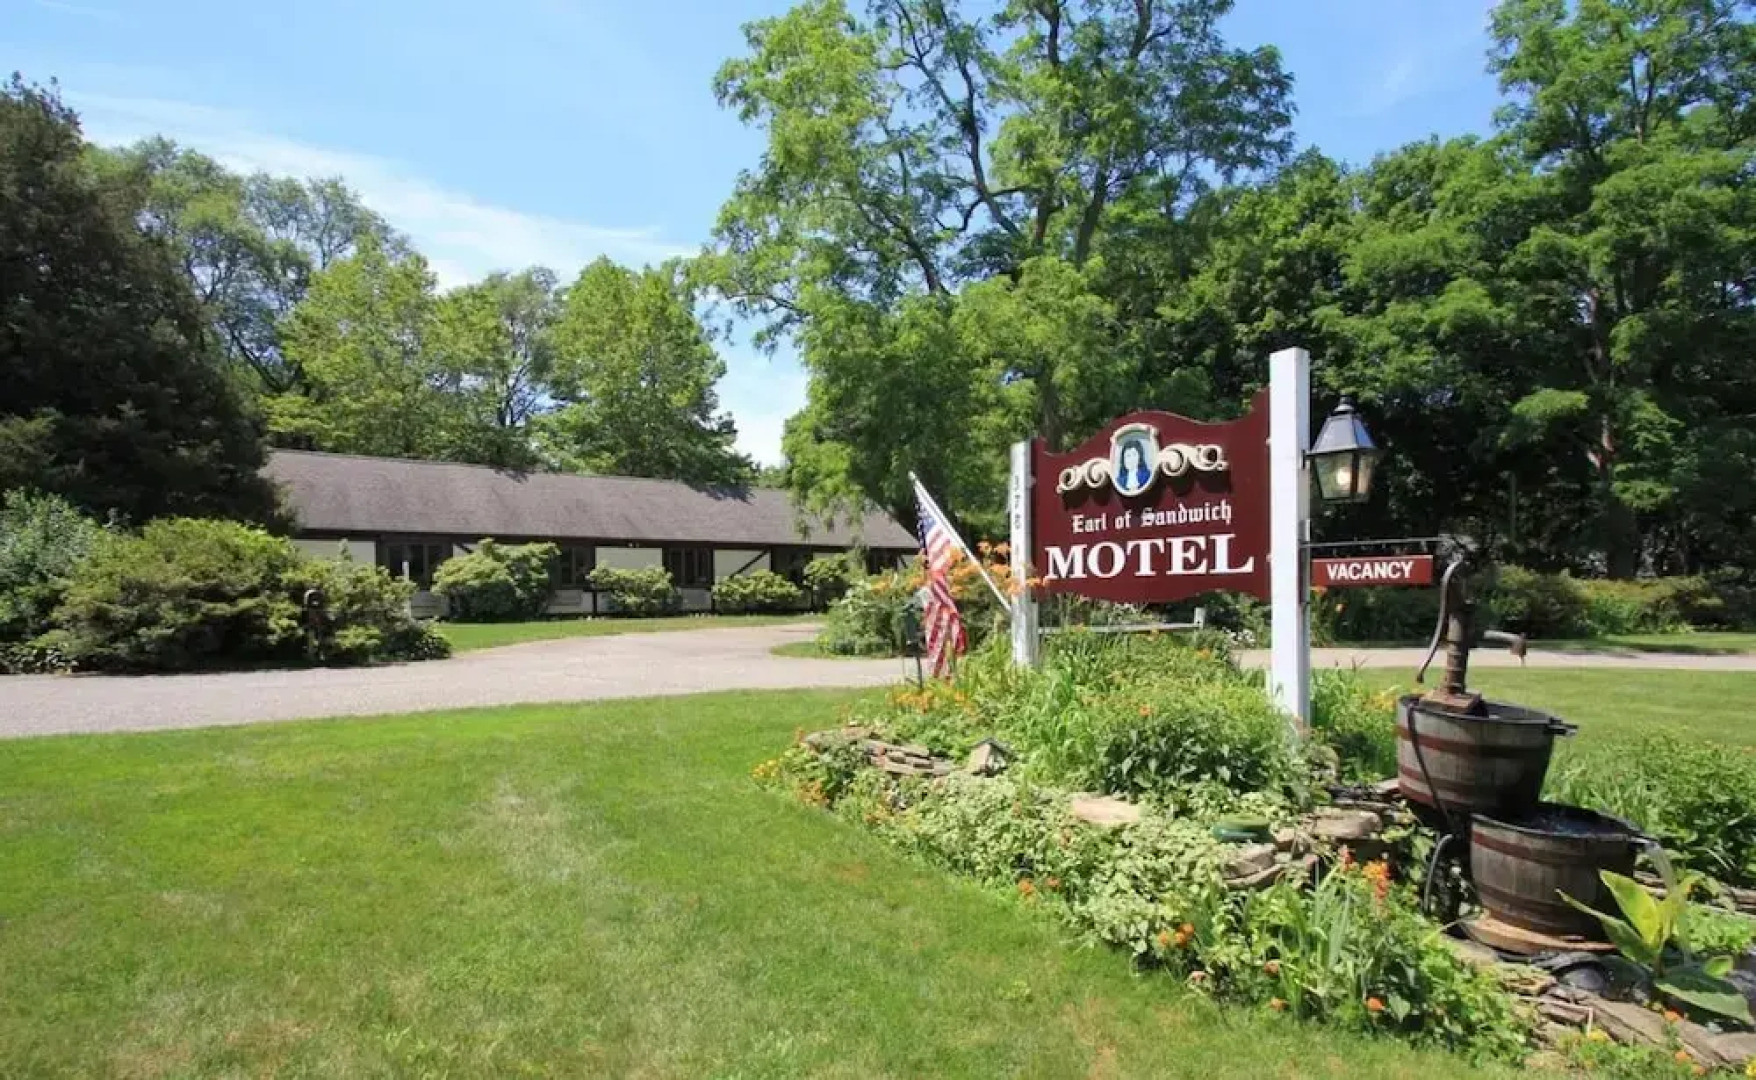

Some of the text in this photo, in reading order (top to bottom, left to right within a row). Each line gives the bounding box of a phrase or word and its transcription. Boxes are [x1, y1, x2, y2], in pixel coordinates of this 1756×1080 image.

[1072, 499, 1232, 534] Earl of Sandwich
[1044, 533, 1255, 581] MOTEL
[1326, 561, 1415, 580] VACANCY
